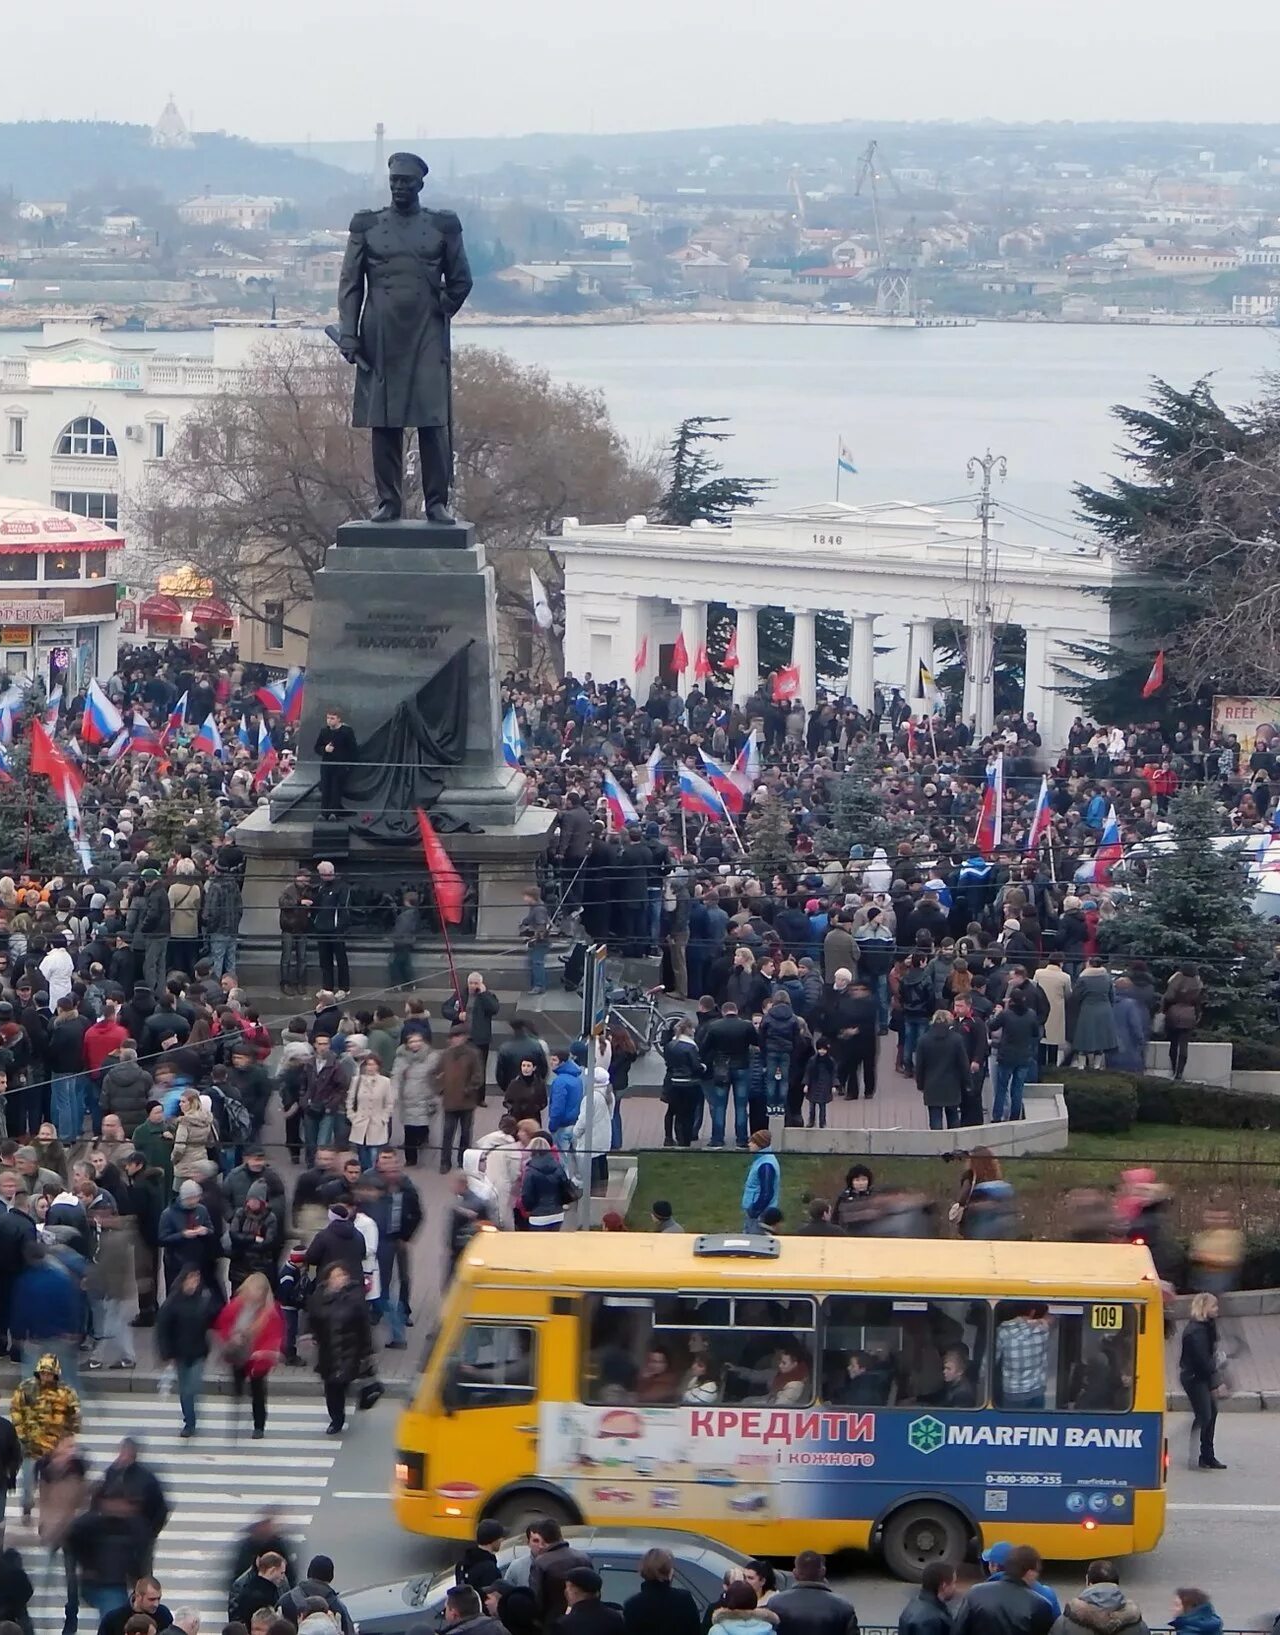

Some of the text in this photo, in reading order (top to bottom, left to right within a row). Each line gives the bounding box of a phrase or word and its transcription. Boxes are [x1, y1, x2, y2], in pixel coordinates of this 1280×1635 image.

[1095, 1306, 1116, 1327] 109
[690, 1410, 876, 1445] КРЕДИТИ
[947, 1425, 1144, 1449] MARFIN BANK
[789, 1452, 875, 1467] кожного
[985, 1475, 1062, 1485] 0-800-500-255
